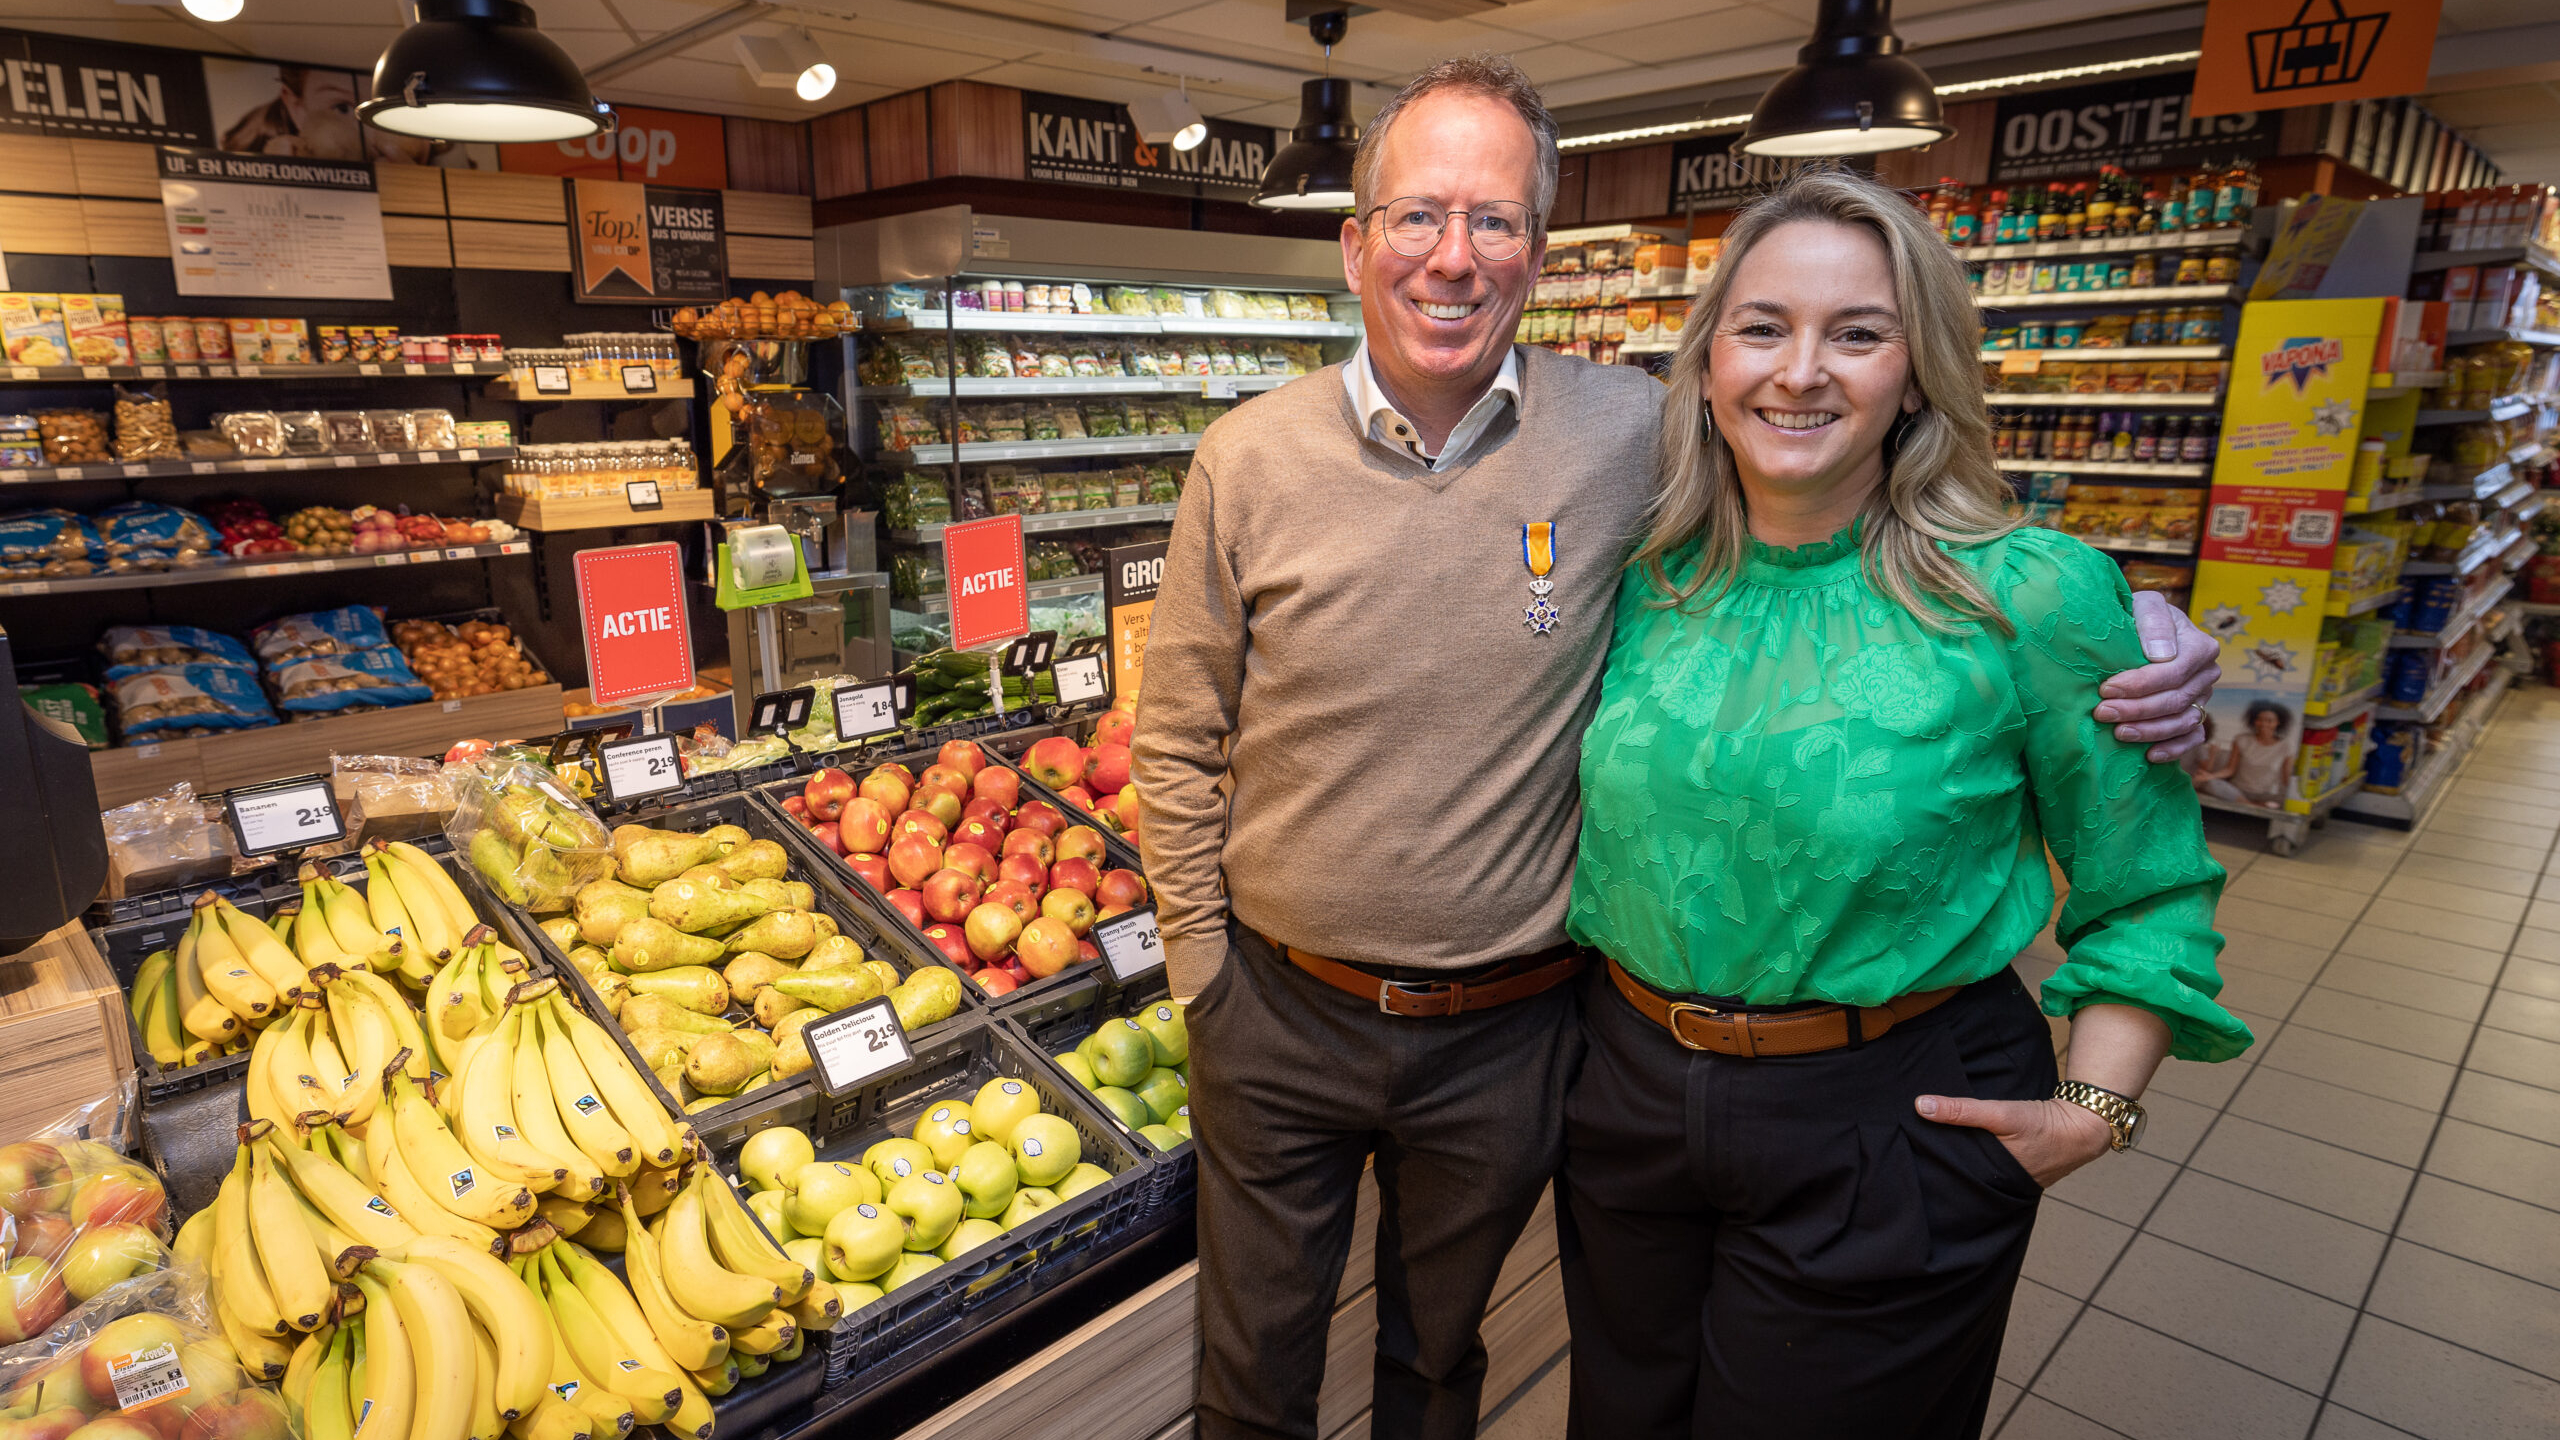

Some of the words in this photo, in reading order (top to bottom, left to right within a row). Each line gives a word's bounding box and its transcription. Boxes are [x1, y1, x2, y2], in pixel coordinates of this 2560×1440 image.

[0, 58, 167, 126] ELEN
[1029, 112, 1126, 163] KANT
[1134, 129, 1159, 167] &
[198, 158, 223, 175] EN
[650, 205, 714, 229] VERSE
[586, 210, 642, 244] Top!
[652, 229, 669, 240] JUS
[671, 230, 715, 242] D'ORANGE
[962, 567, 1014, 597] ACTIE
[1122, 557, 1165, 589] GRO
[602, 606, 672, 639] ACTIE
[1123, 614, 1145, 626] Vers
[1124, 629, 1132, 641] &
[1134, 625, 1150, 639] alti
[1124, 644, 1132, 655] &
[1125, 658, 1133, 670] &
[839, 693, 863, 703] Jonagold
[872, 700, 893, 718] 1.84
[606, 748, 644, 760] Conference
[644, 745, 662, 754] peren
[647, 756, 676, 776] 2.19
[238, 802, 278, 813] Bananen
[296, 805, 334, 827] 2.19
[1100, 927, 1120, 939] Granny
[1120, 921, 1137, 931] Smith
[814, 1026, 841, 1041] Golden
[841, 1013, 875, 1030] Delicious
[864, 1023, 896, 1052] 2.19
